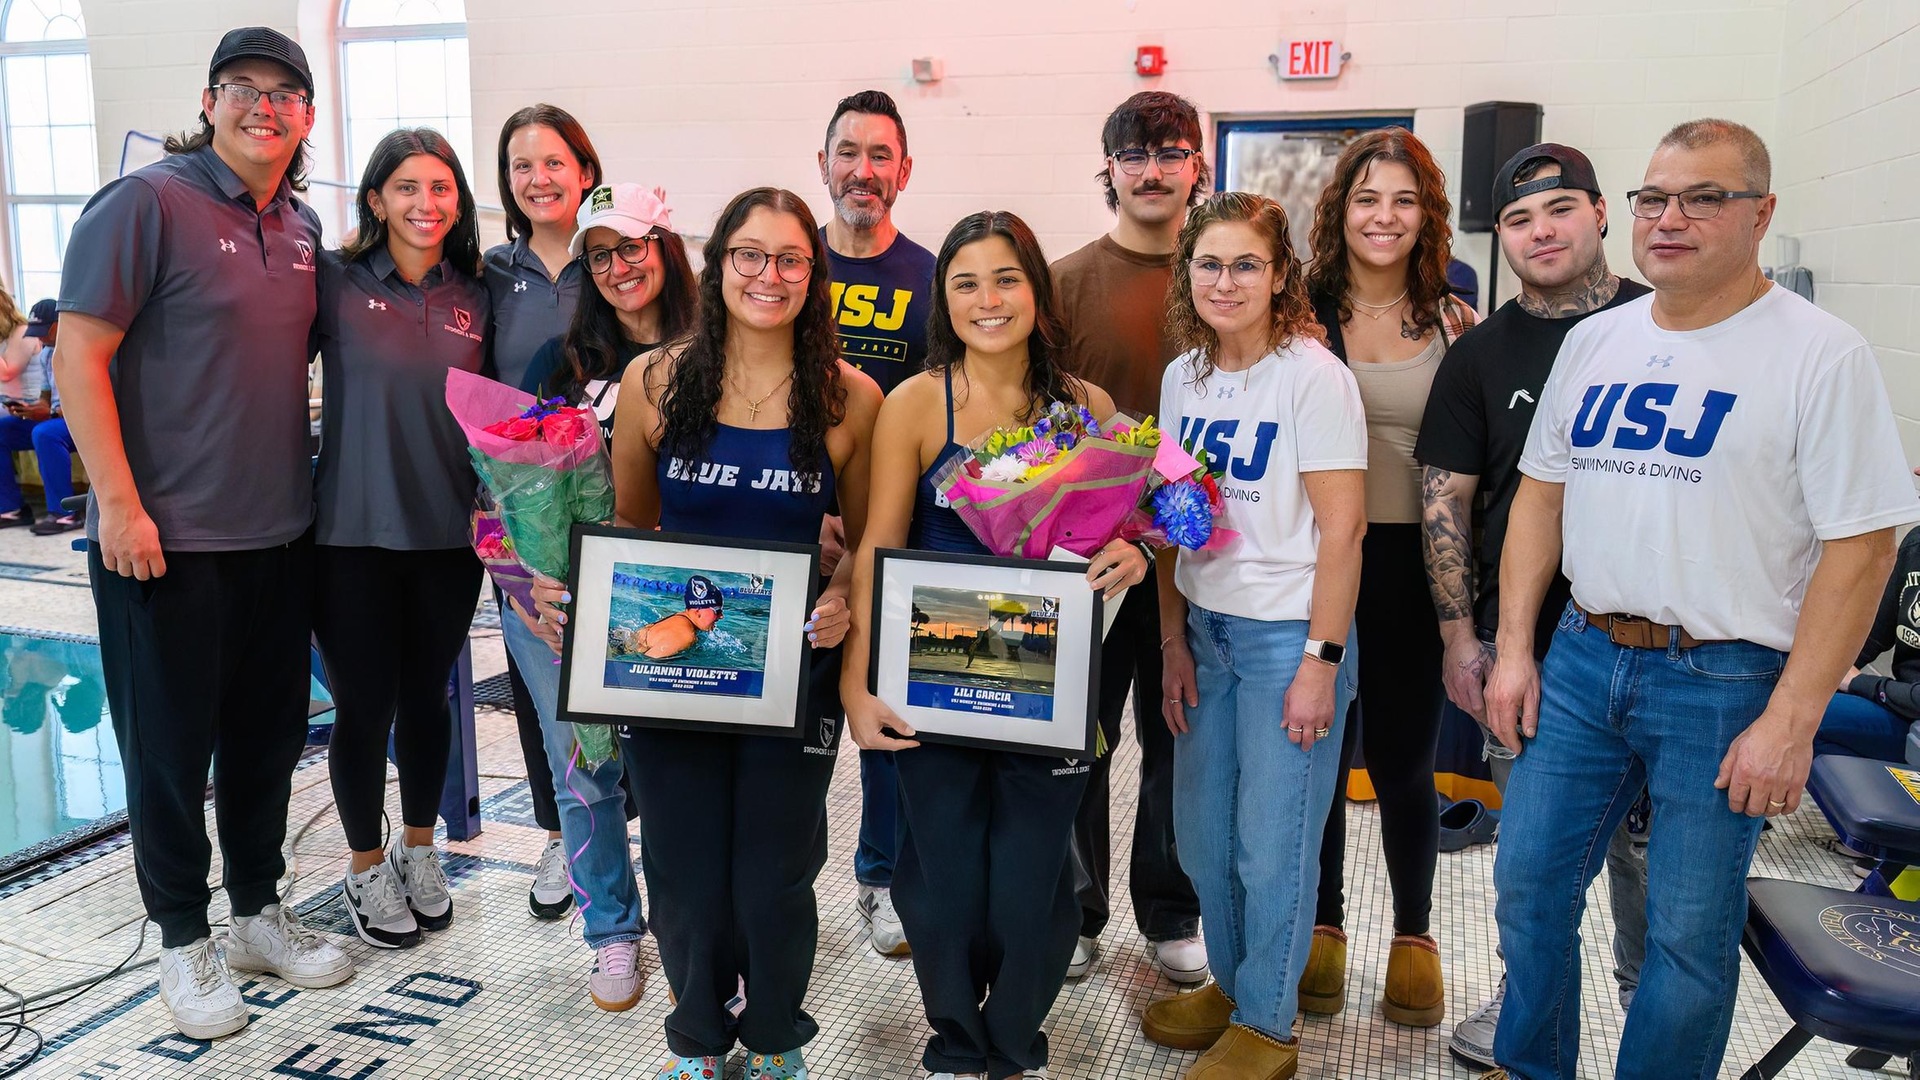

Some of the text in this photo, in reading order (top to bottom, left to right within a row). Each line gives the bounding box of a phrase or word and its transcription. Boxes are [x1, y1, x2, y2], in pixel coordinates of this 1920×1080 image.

[1289, 41, 1333, 75] EXIT
[861, 343, 899, 354] JAYS
[1571, 382, 1738, 458] USJ
[1638, 463, 1646, 476] &
[1650, 463, 1702, 484] DIVING
[1224, 487, 1261, 503] DIVING
[629, 664, 738, 681] JULIANNA VIOLETTE
[954, 688, 1011, 702] LILI GARCIA
[270, 971, 484, 1080] END
